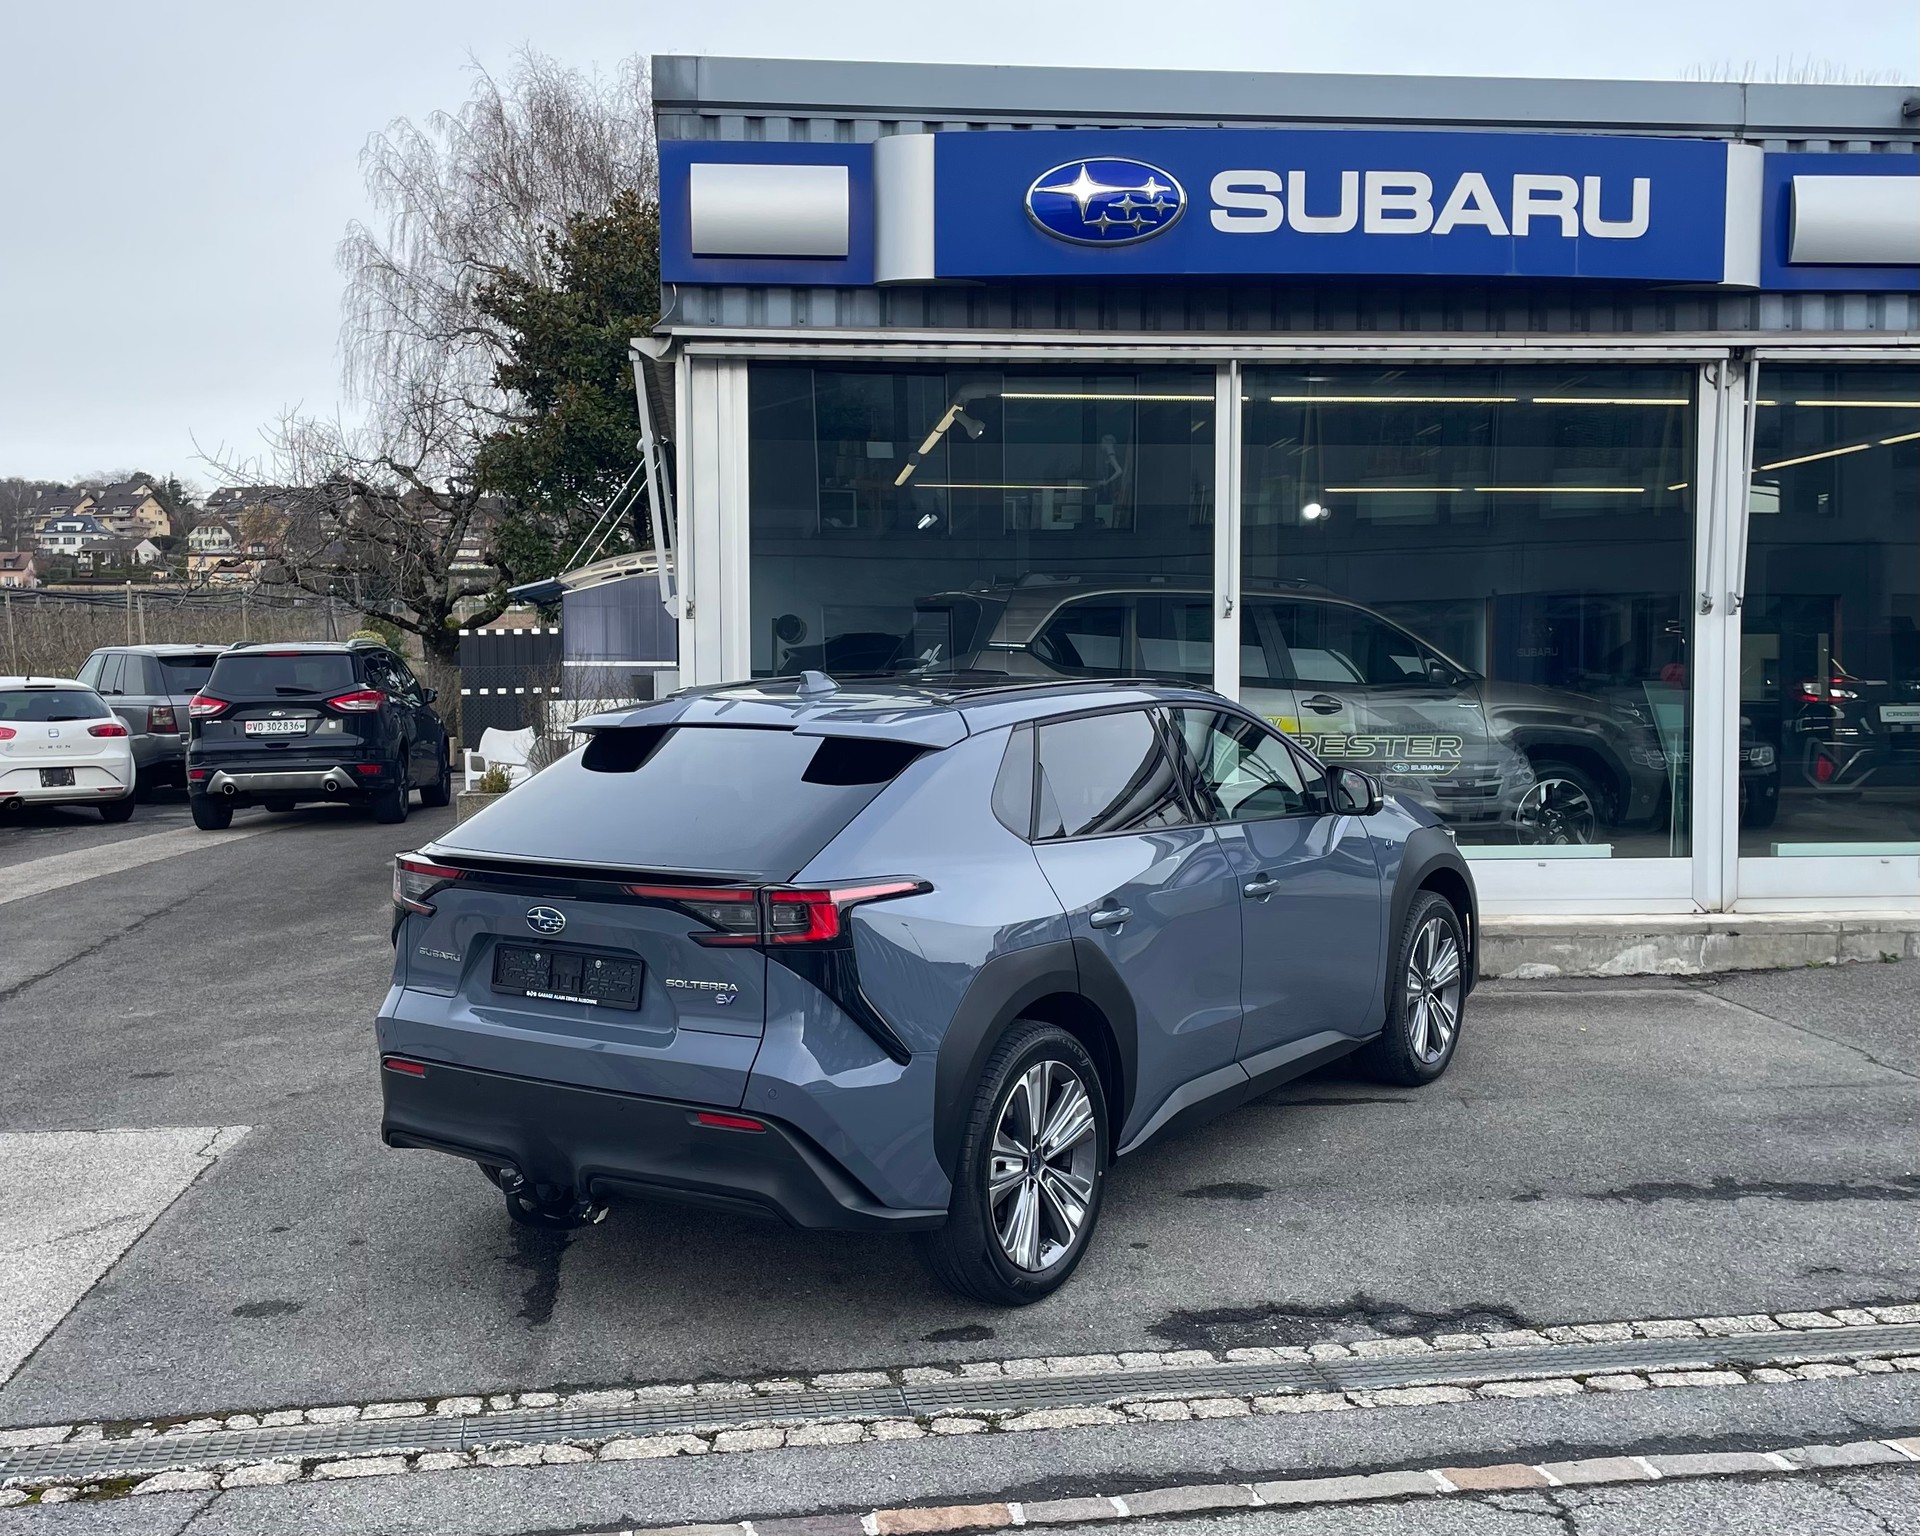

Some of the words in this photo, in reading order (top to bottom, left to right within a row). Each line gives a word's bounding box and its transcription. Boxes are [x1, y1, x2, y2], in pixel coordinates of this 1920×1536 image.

[1210, 170, 1650, 238] SUBARU
[1516, 647, 1559, 657] SUBARU
[253, 722, 264, 731] VD
[267, 721, 299, 731] 302836
[1293, 735, 1462, 758] RESTER
[419, 946, 461, 962] SUBARU
[665, 979, 739, 992] SOLTERRA
[715, 993, 736, 1005] EV
